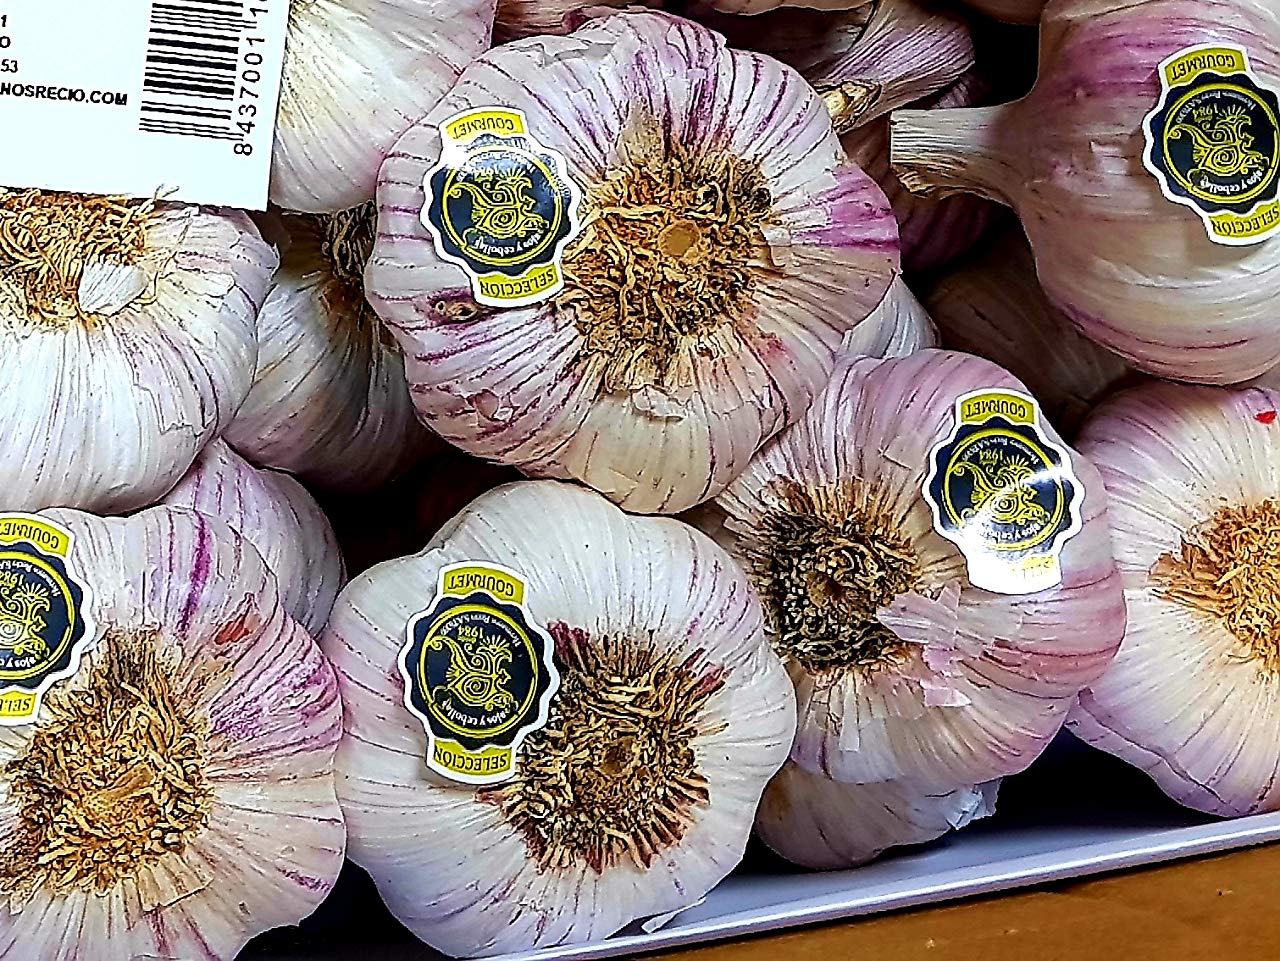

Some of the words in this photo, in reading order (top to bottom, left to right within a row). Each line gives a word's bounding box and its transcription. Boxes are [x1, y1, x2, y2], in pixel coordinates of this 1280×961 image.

[1172, 55, 1235, 79] GOURMET
[453, 118, 513, 138] GOURMET
[965, 400, 1025, 416] GOURMET
[448, 574, 514, 595] GOURMET
